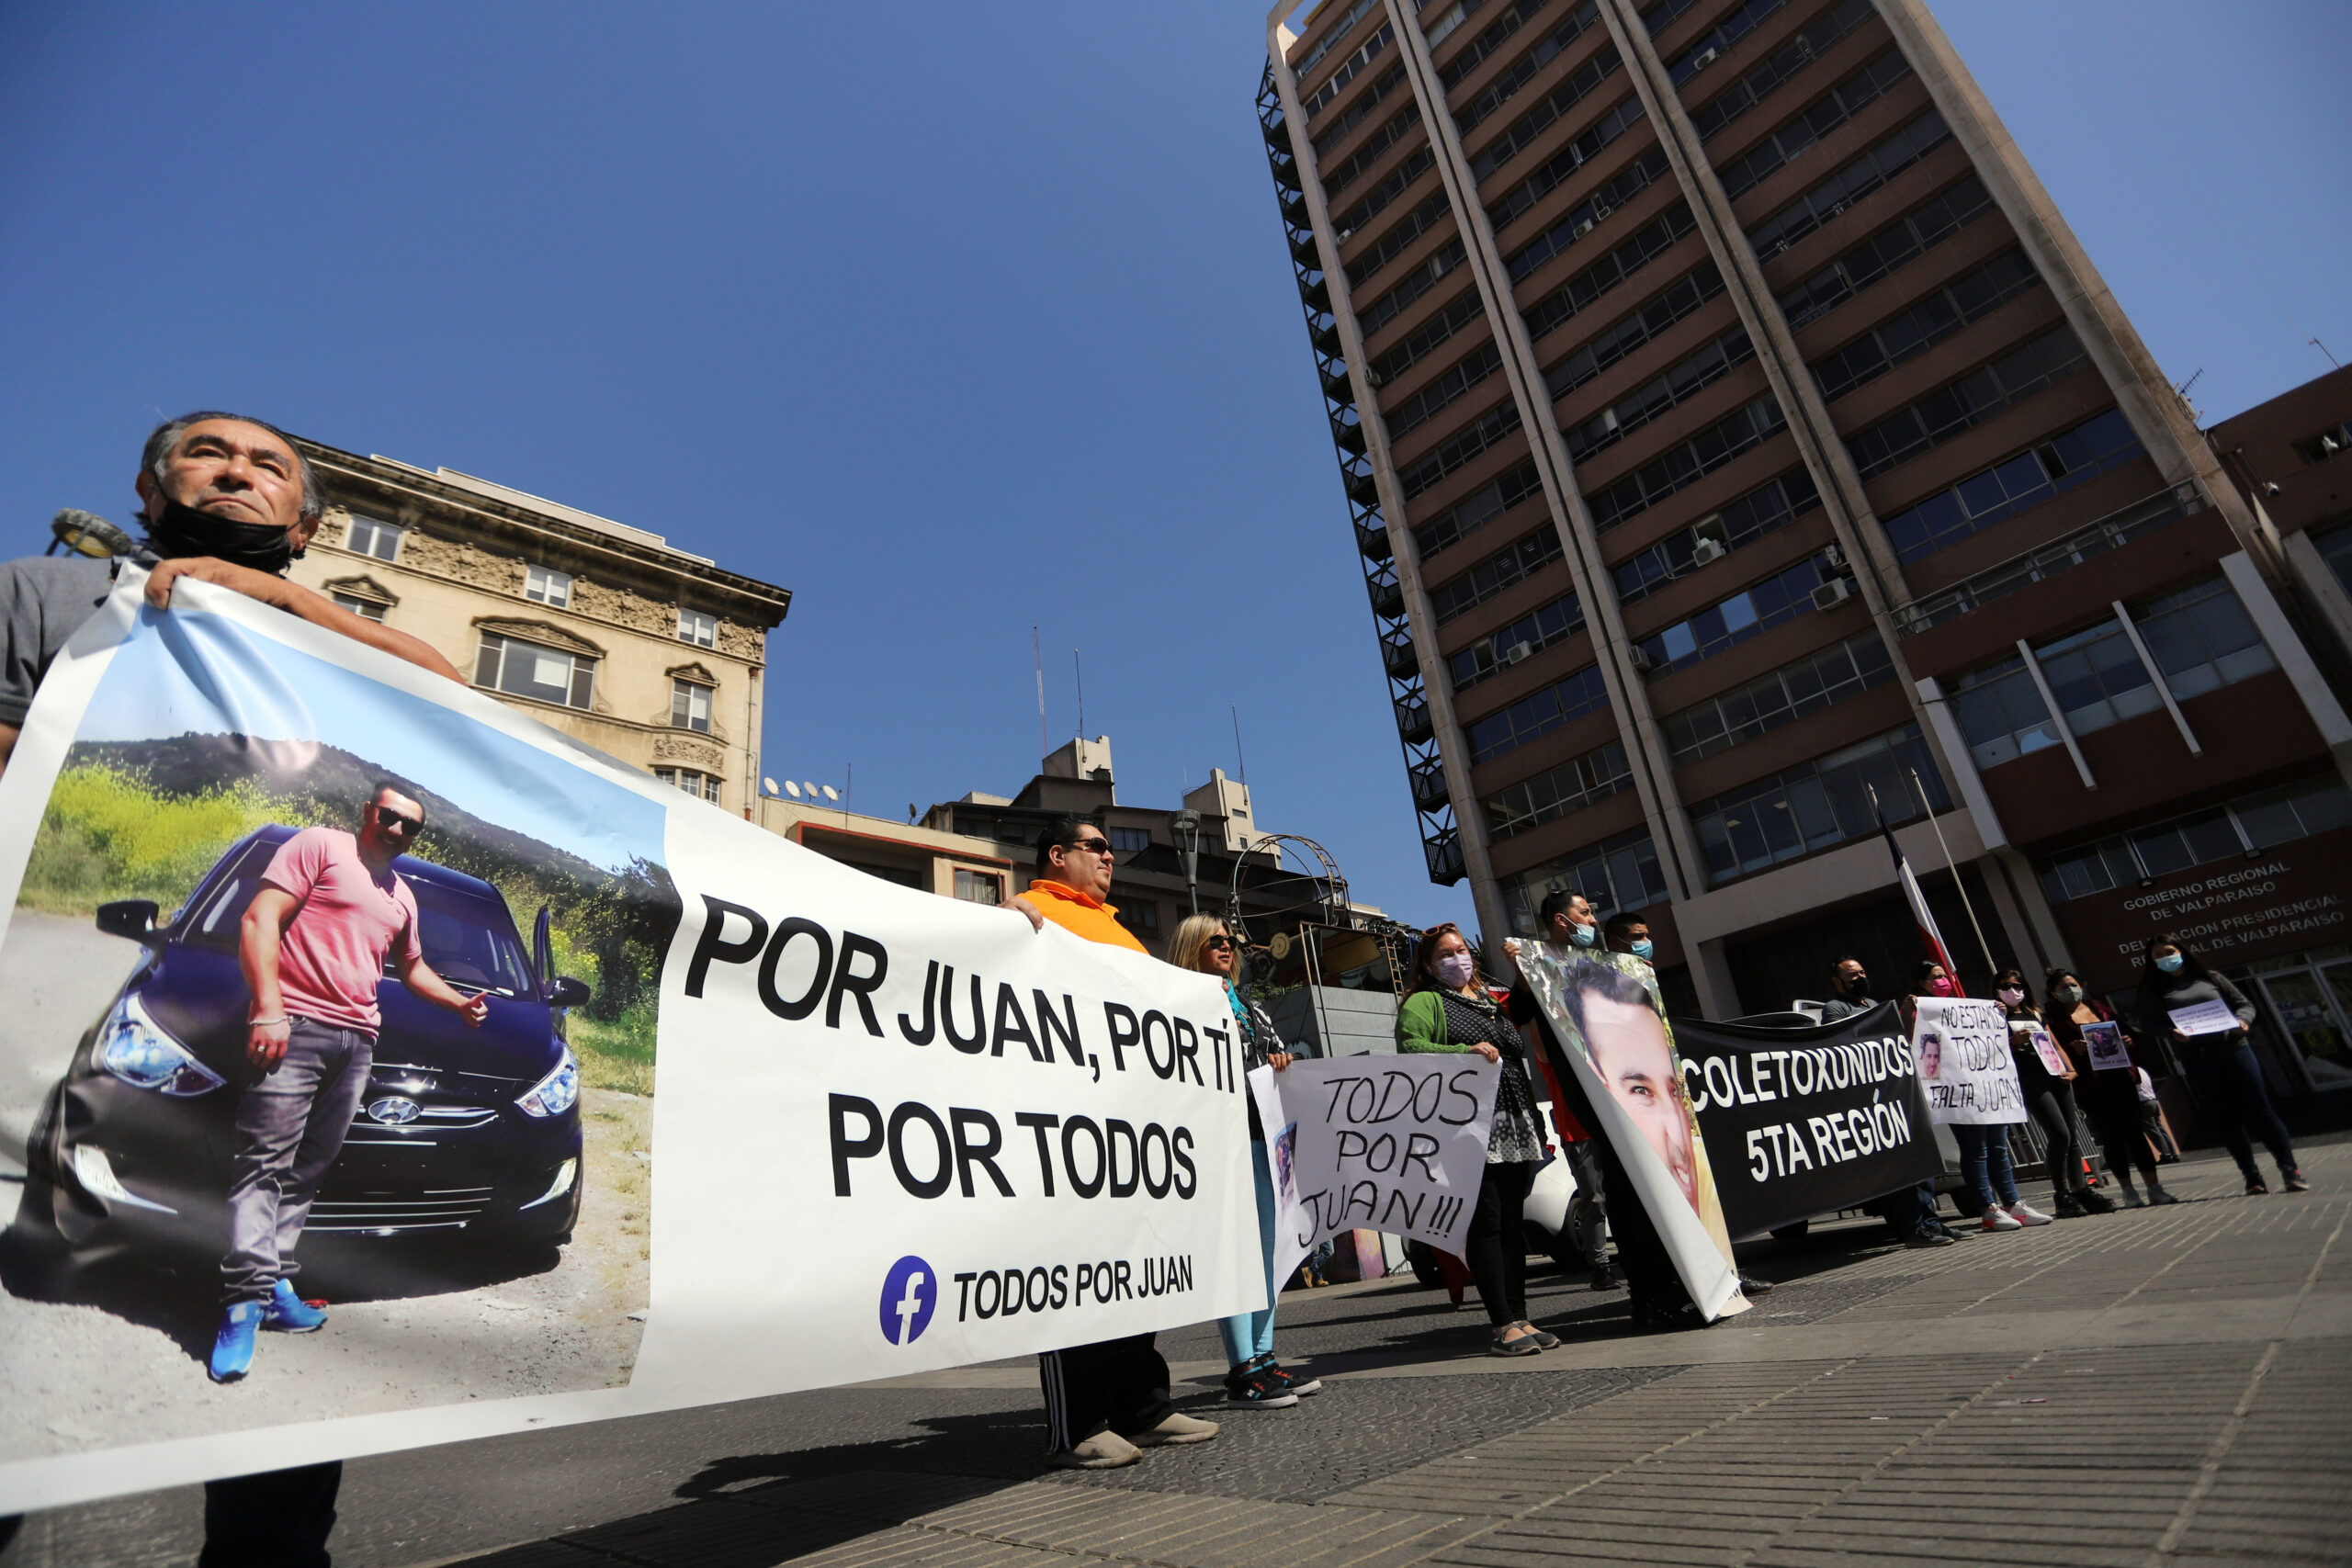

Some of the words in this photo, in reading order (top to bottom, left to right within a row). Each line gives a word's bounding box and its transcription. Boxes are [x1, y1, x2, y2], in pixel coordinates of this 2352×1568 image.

[2123, 883, 2203, 910] GOBIERNO
[2205, 862, 2290, 890] REGIONAL
[2150, 908, 2172, 920] DE
[2175, 881, 2276, 914] VALPARAISO
[2119, 921, 2219, 953] DELACION
[2222, 893, 2344, 931] PRESIDENCIAL
[2211, 935, 2234, 950] DE
[2236, 910, 2344, 943] VALPARAISO
[684, 893, 888, 1039] POR
[898, 960, 1101, 1084] JUAN,
[1103, 1001, 1204, 1088] POR
[1203, 1019, 1235, 1093] TÍ
[1941, 1007, 1958, 1028] NO
[1680, 1034, 1915, 1112] COLETOXUNIDOS
[1951, 1034, 2007, 1072] TODOS
[1323, 1070, 1478, 1126] TODOS
[1929, 1083, 1974, 1110] FALTA
[1977, 1077, 2023, 1112] JUAN
[828, 1092, 1016, 1200] POR
[1014, 1111, 1197, 1200] TODOS
[1336, 1131, 1440, 1183] POR
[1746, 1122, 1814, 1182] 5TA
[1806, 1089, 1912, 1168] REGIÓN
[954, 1264, 1069, 1323] TODOS
[1075, 1260, 1134, 1307] POR
[1137, 1255, 1193, 1298] JUAN
